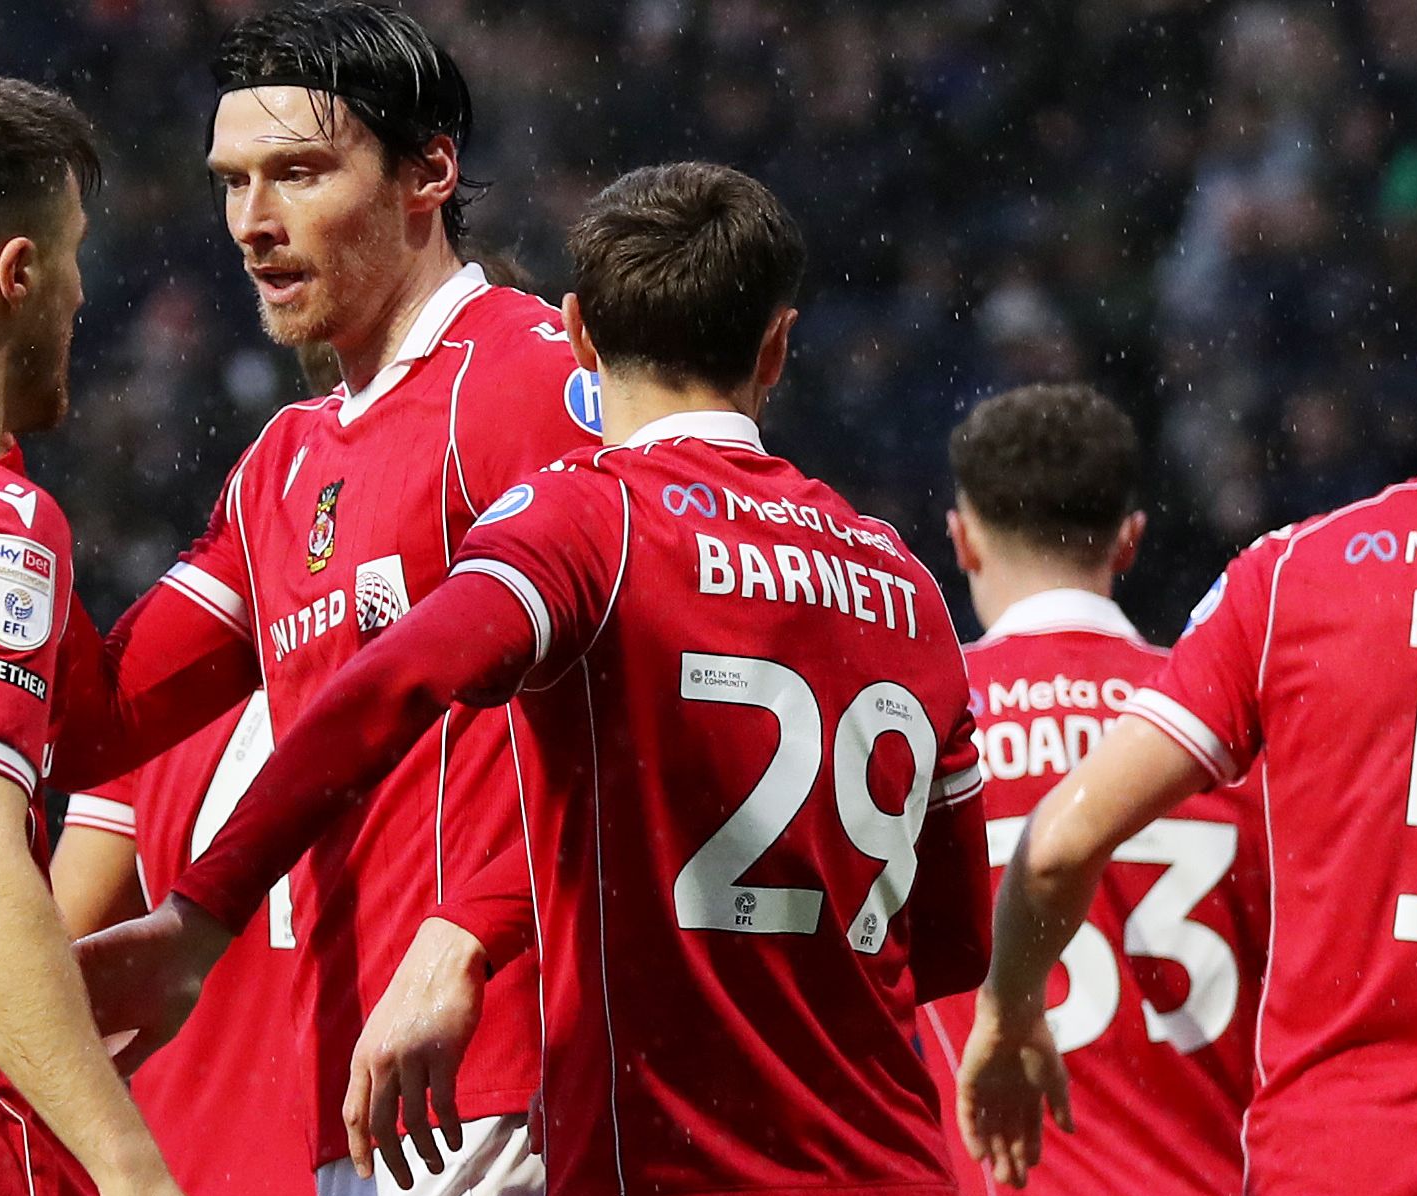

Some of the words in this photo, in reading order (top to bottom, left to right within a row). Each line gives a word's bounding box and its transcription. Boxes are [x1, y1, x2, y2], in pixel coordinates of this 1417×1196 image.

[721, 487, 823, 532] Meta
[25, 551, 50, 575] bet
[696, 532, 917, 640] BARNETT
[3, 620, 27, 638] EFL
[988, 673, 1098, 715] Meta
[674, 651, 938, 955] 29
[735, 915, 753, 926] EFL
[860, 936, 873, 946] EFL
